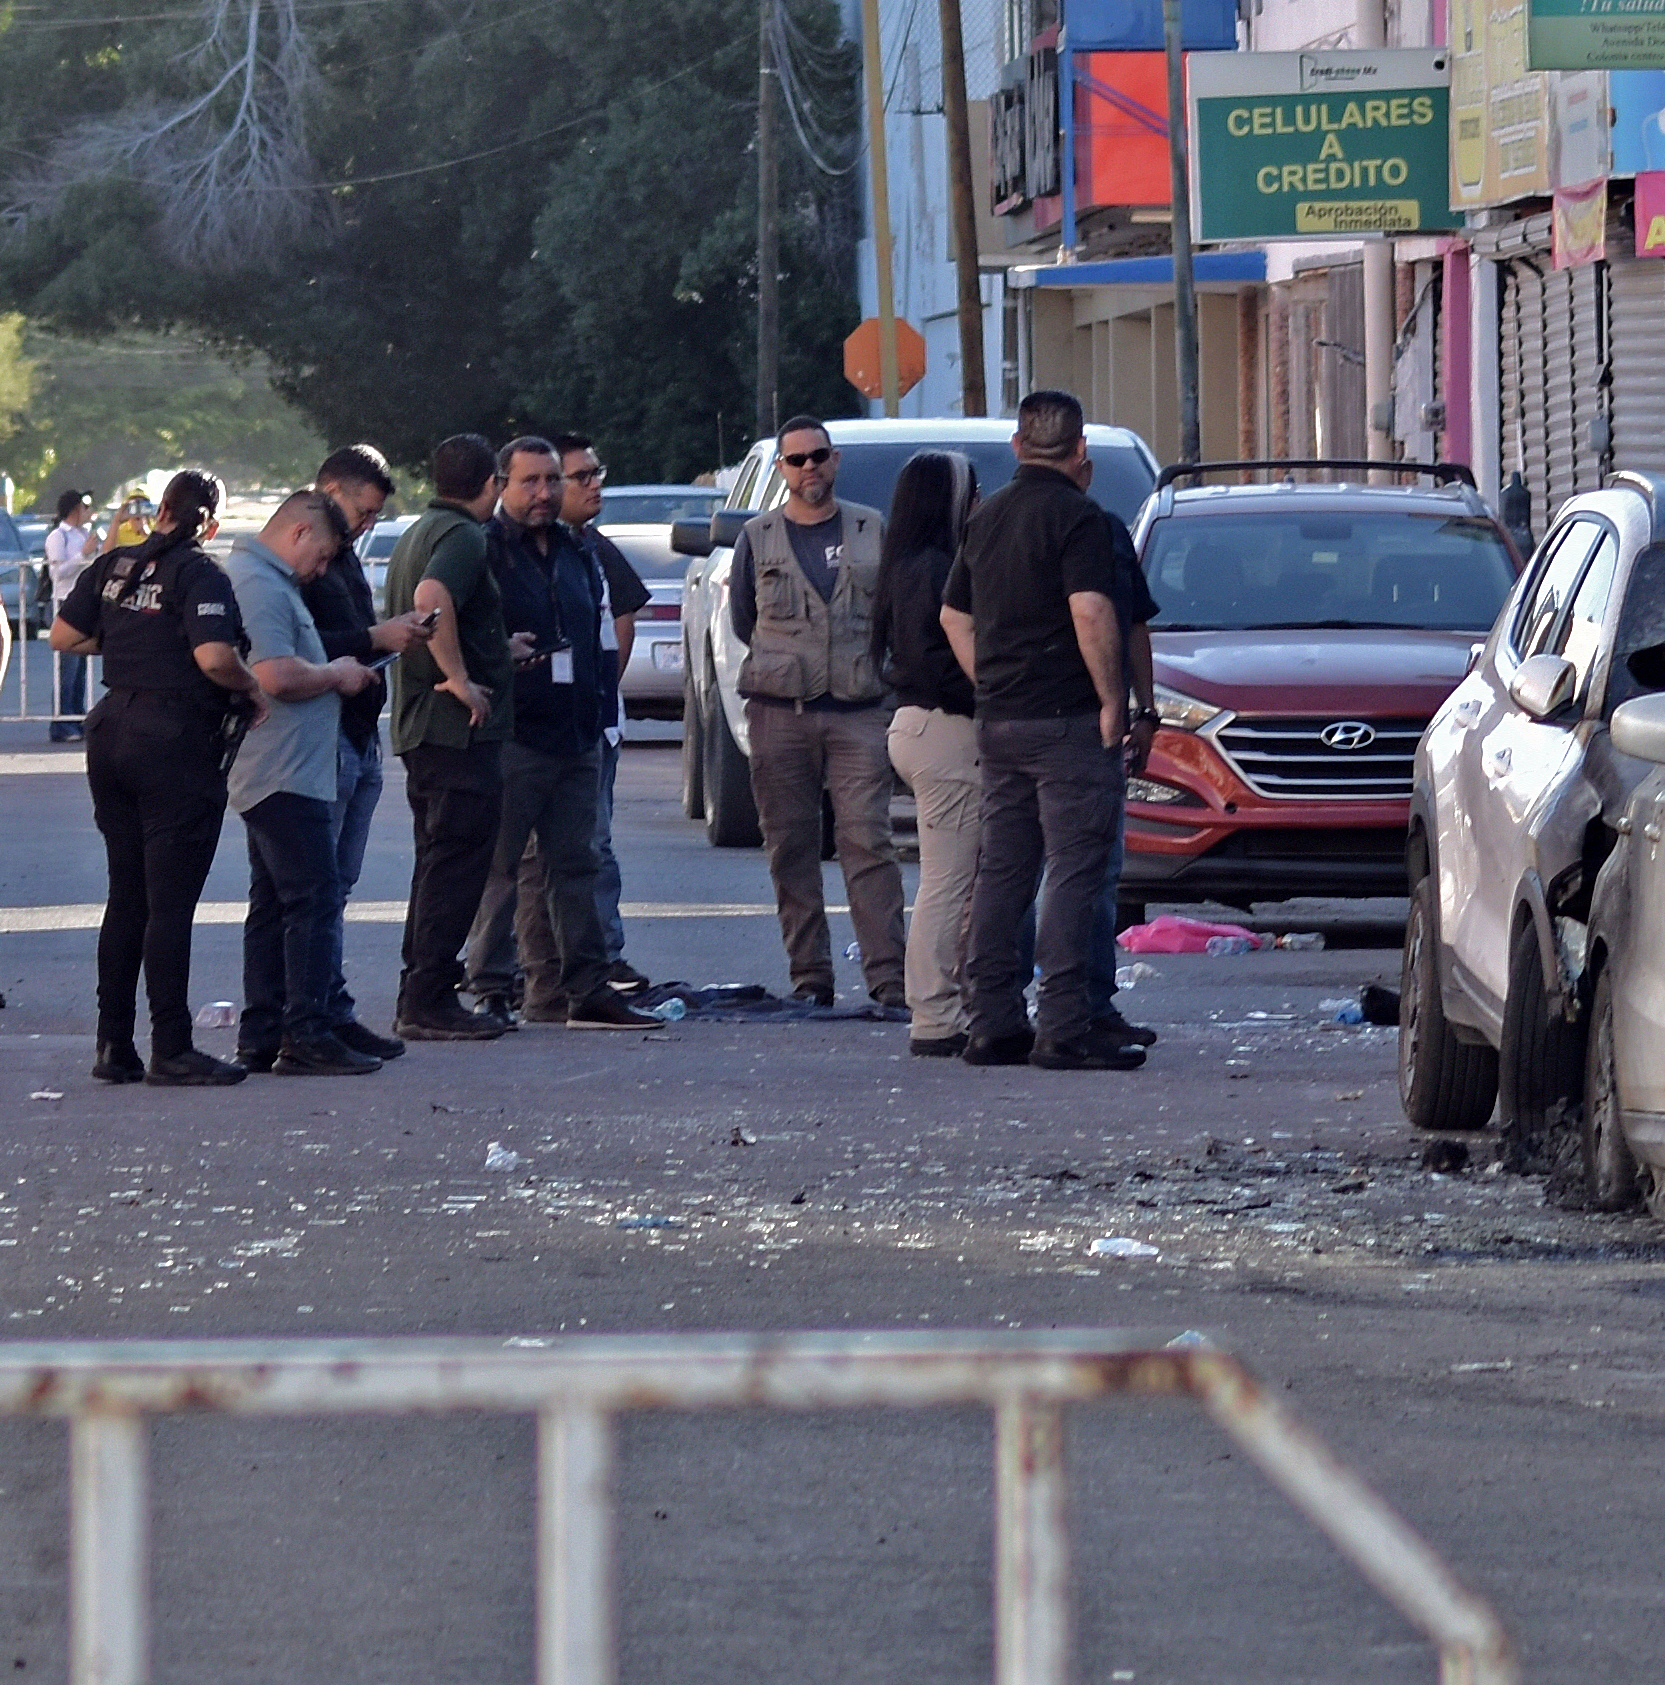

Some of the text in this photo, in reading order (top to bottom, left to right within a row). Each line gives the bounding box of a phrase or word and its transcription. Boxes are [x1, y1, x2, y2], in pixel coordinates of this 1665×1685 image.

[1227, 96, 1434, 137] CELULARES
[1318, 132, 1344, 161] A
[1304, 202, 1399, 220] Aprobación
[1333, 215, 1412, 230] Inmediata
